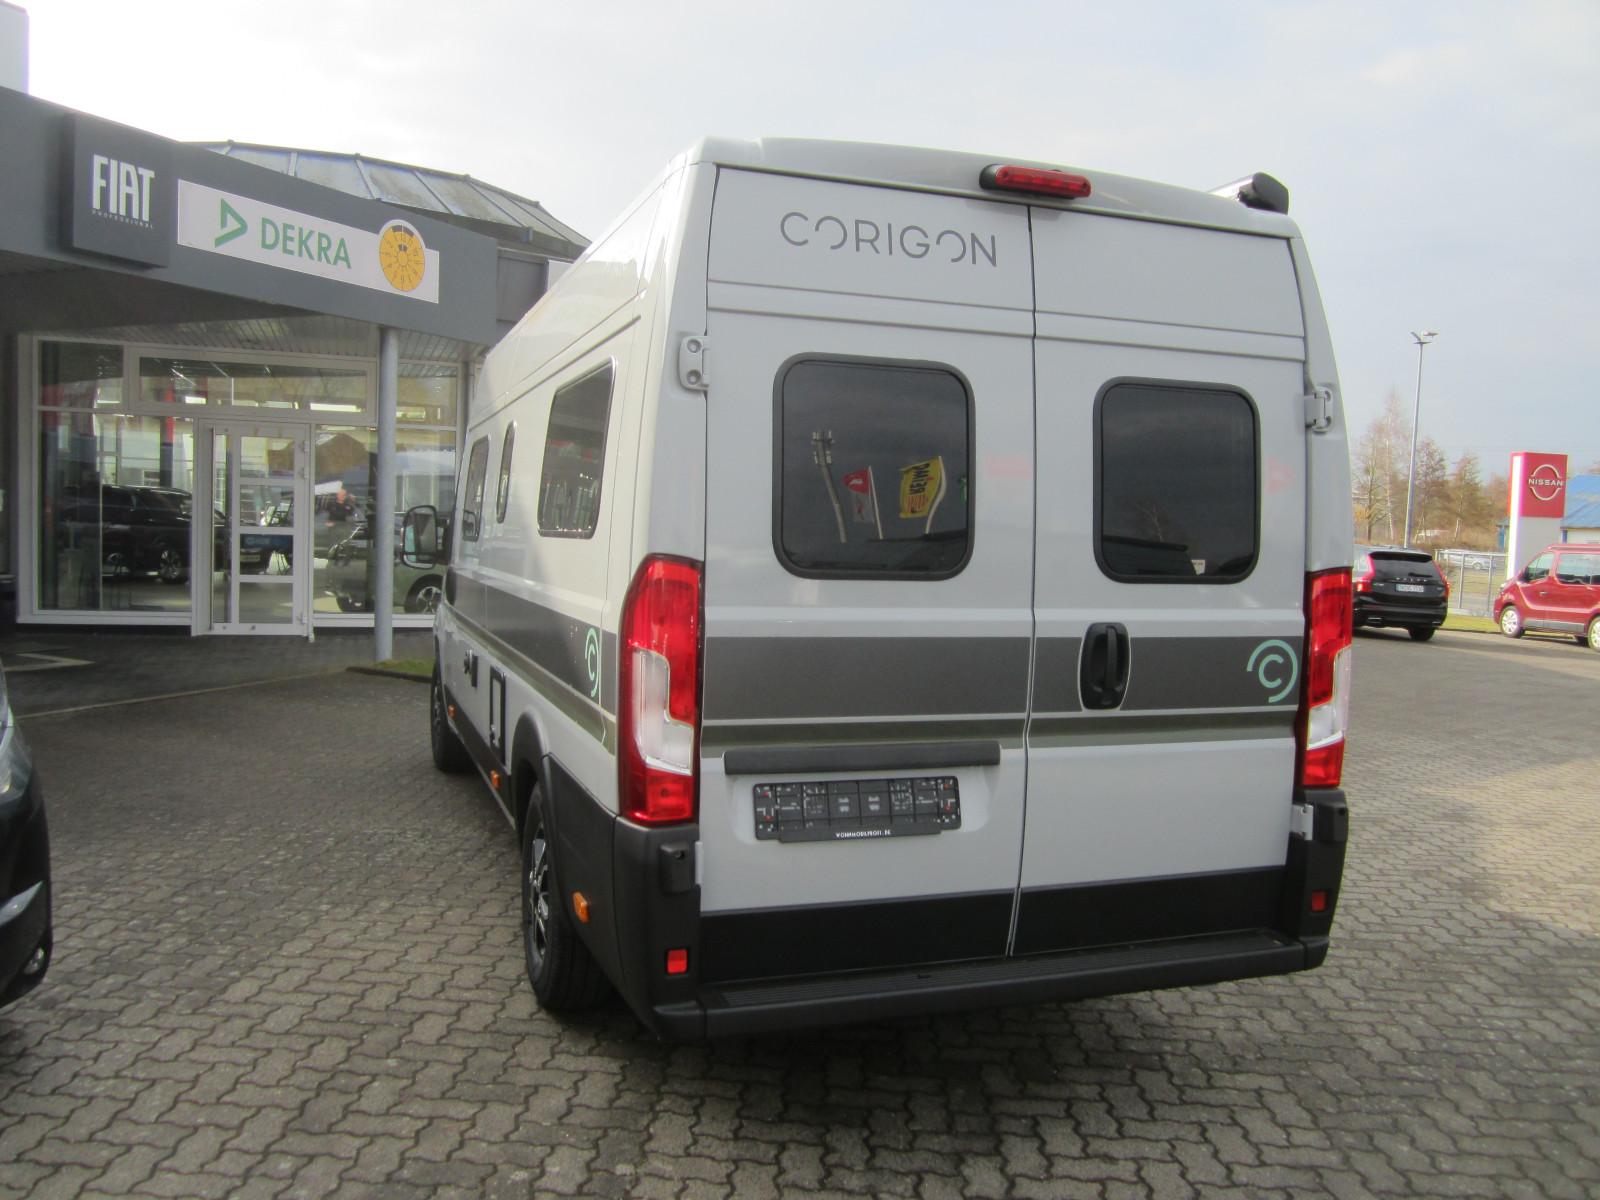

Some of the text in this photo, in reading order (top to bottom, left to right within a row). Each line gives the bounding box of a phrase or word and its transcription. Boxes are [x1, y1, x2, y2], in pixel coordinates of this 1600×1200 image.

[93, 154, 155, 222] FIAT
[261, 216, 352, 269] DEKRA
[780, 211, 997, 267] CORIGON
[1528, 478, 1563, 486] NISSAN
